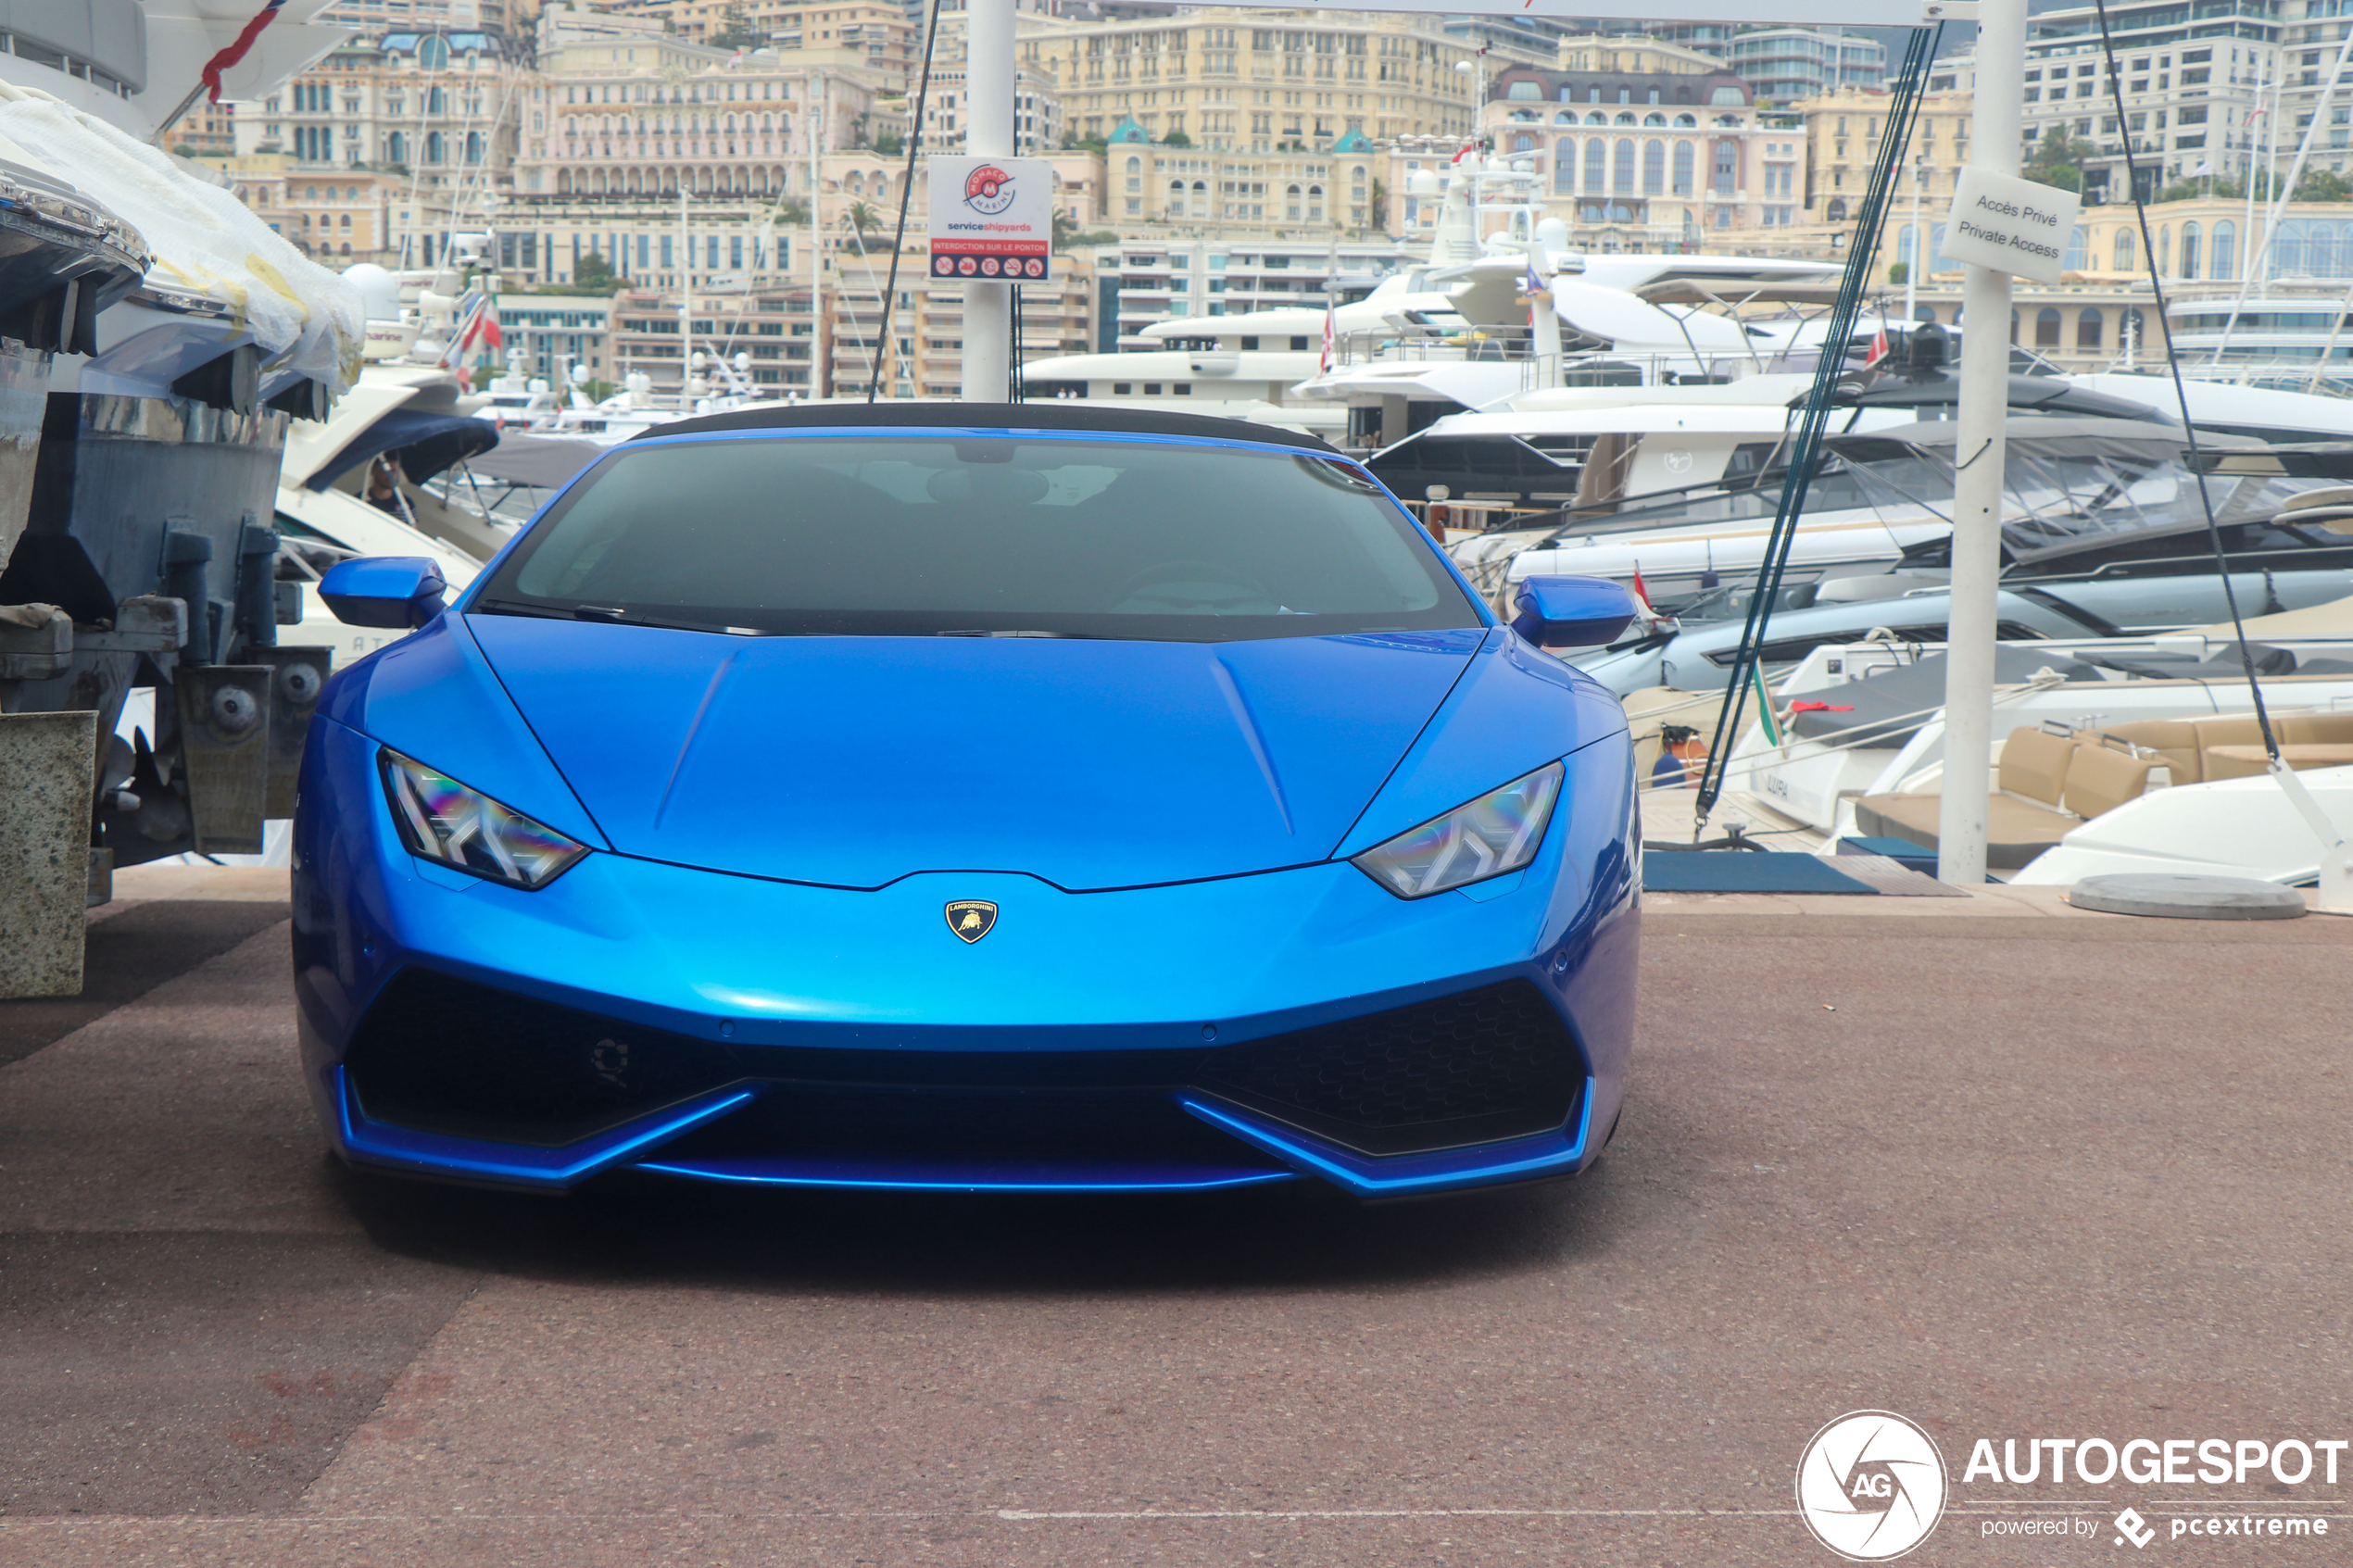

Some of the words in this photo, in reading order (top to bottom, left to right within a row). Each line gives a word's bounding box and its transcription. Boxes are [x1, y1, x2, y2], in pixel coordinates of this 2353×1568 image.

[971, 169, 1005, 192] MONACO
[984, 183, 996, 194] M
[975, 191, 1011, 209] MARINE
[1976, 195, 2019, 217] Accès
[2022, 207, 2057, 227] Privé
[948, 222, 1031, 232] serviceshipyards
[1958, 220, 2007, 245] Private
[2009, 235, 2059, 258] Access
[1768, 774, 1788, 800] LUPA
[950, 903, 994, 911] LAMBORGHINI
